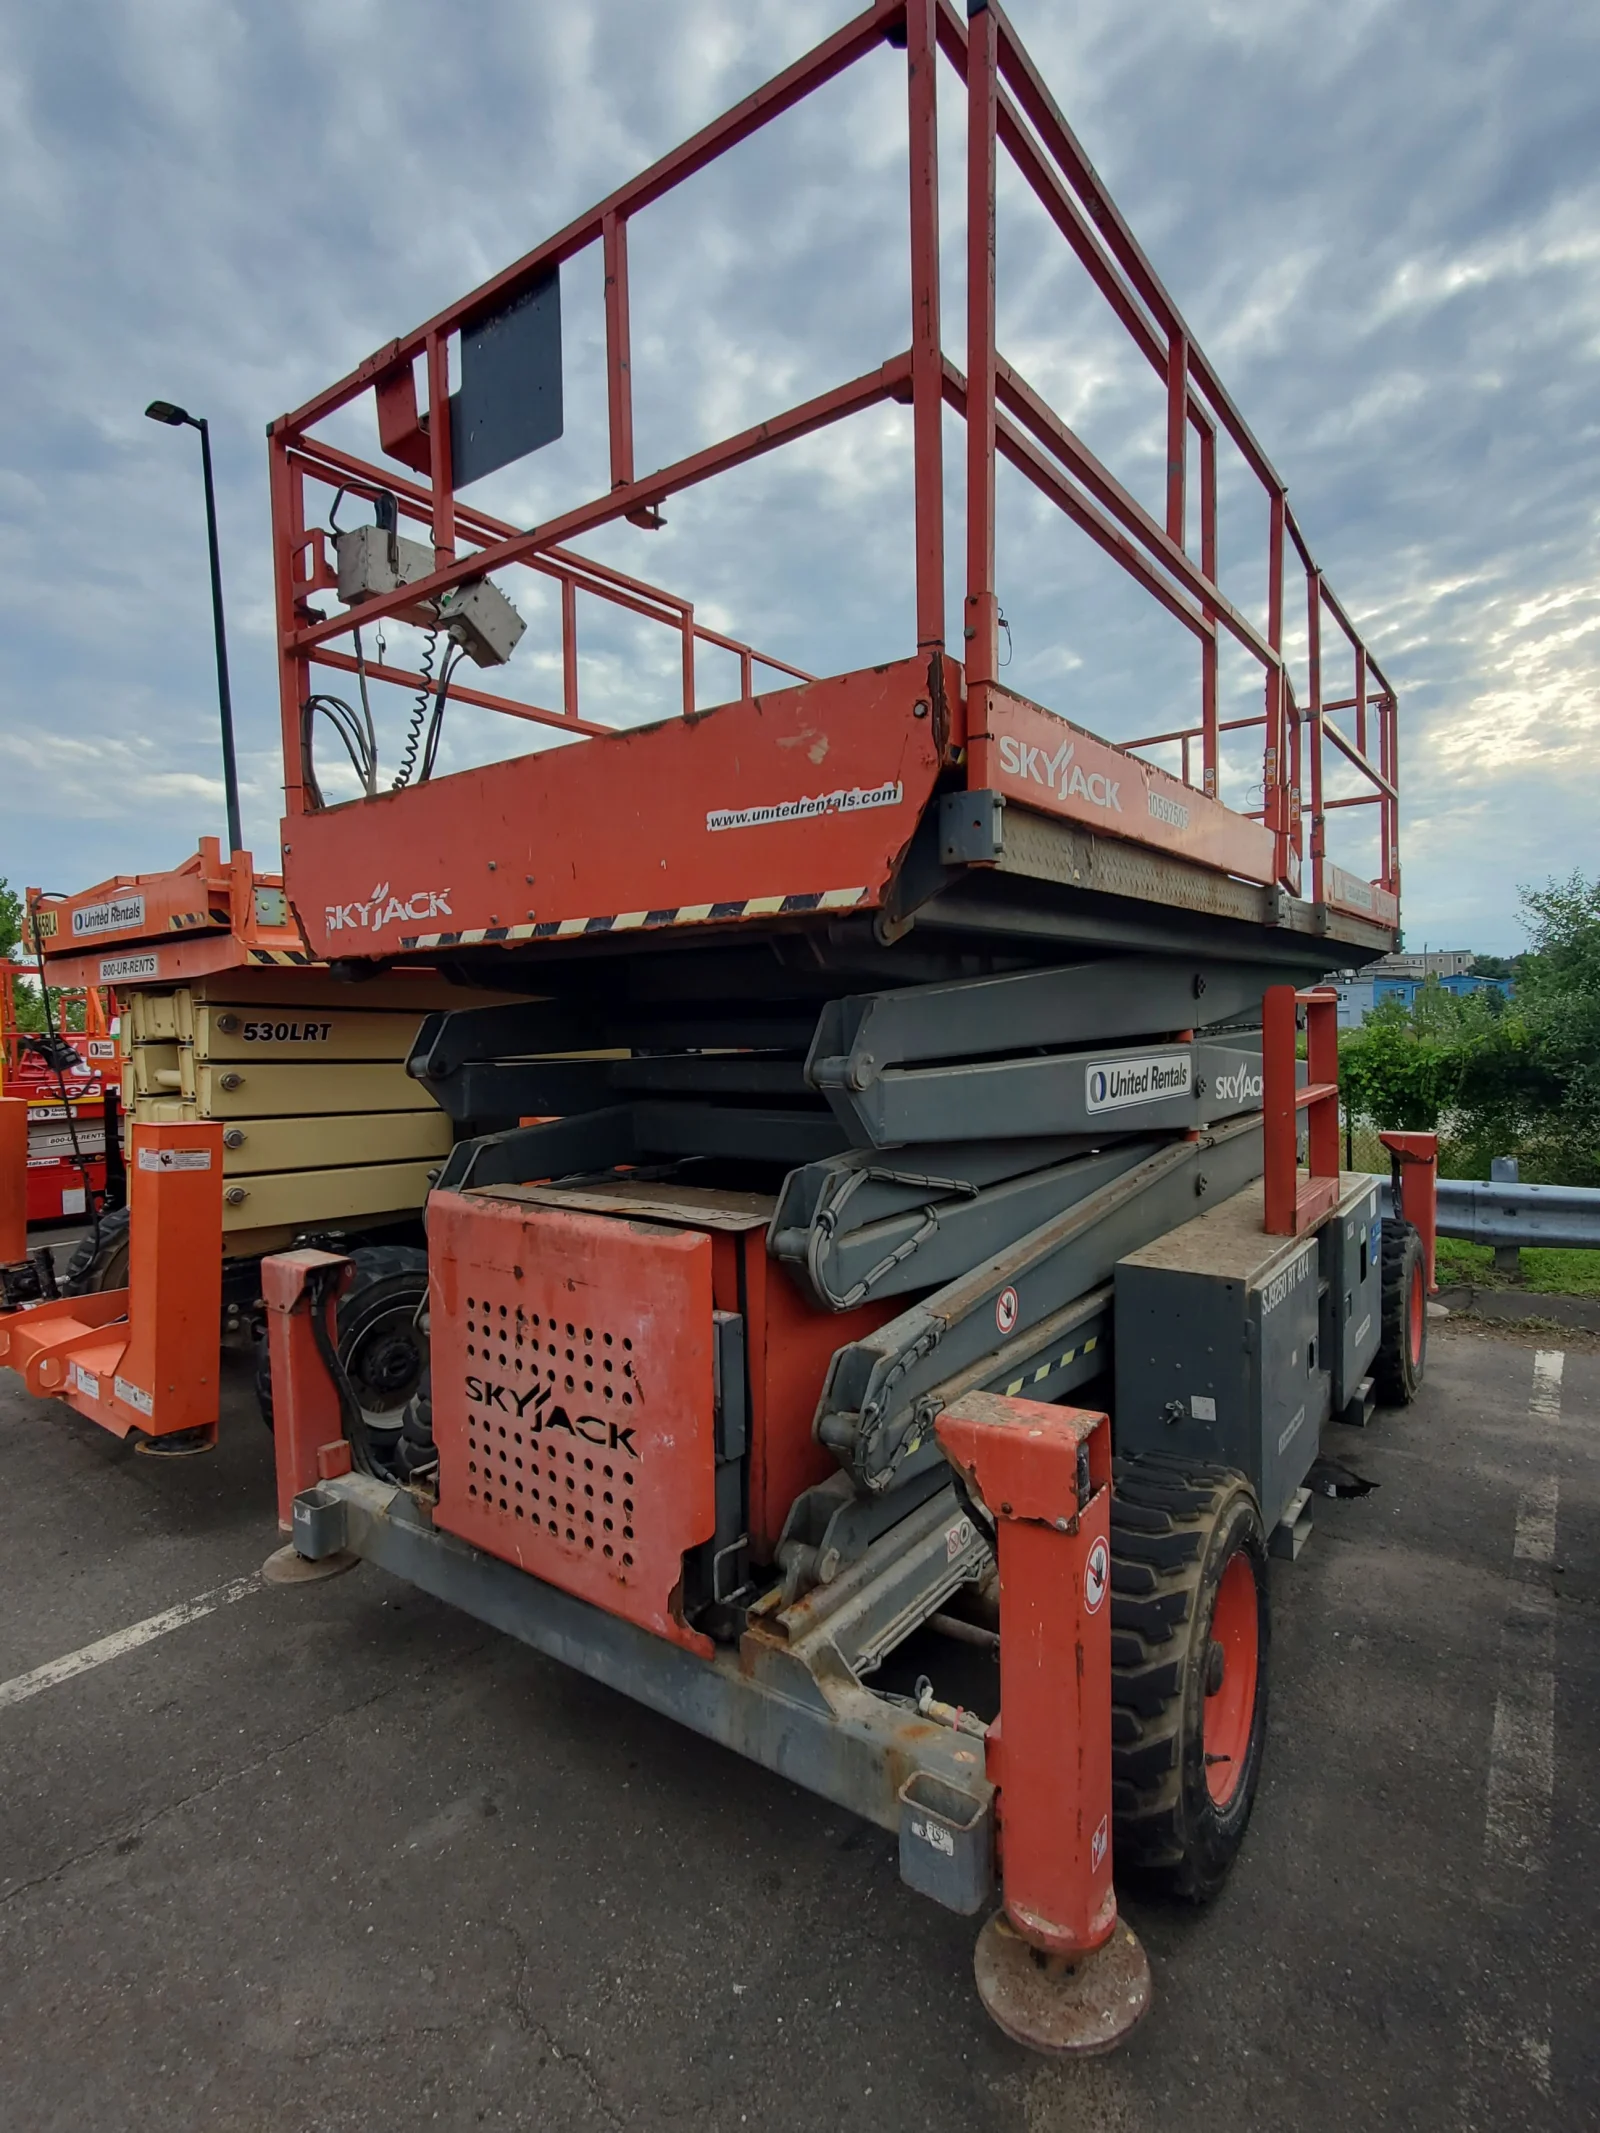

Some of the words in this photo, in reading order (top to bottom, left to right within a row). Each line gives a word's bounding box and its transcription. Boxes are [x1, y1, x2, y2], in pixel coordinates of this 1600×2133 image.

[999, 735, 1122, 813] SKYJACK
[710, 788, 898, 828] www.unitedrentals.com
[84, 909, 109, 928] United
[110, 900, 141, 923] Rentals
[324, 881, 453, 932] SKYJACK
[102, 957, 155, 977] 800-UR-RENTS
[242, 1021, 333, 1041] 530LRT
[1109, 1067, 1148, 1099] United
[1151, 1062, 1188, 1090] Rentals
[1215, 1062, 1264, 1104] SKYJAC
[464, 1375, 639, 1458] SKYJACK
